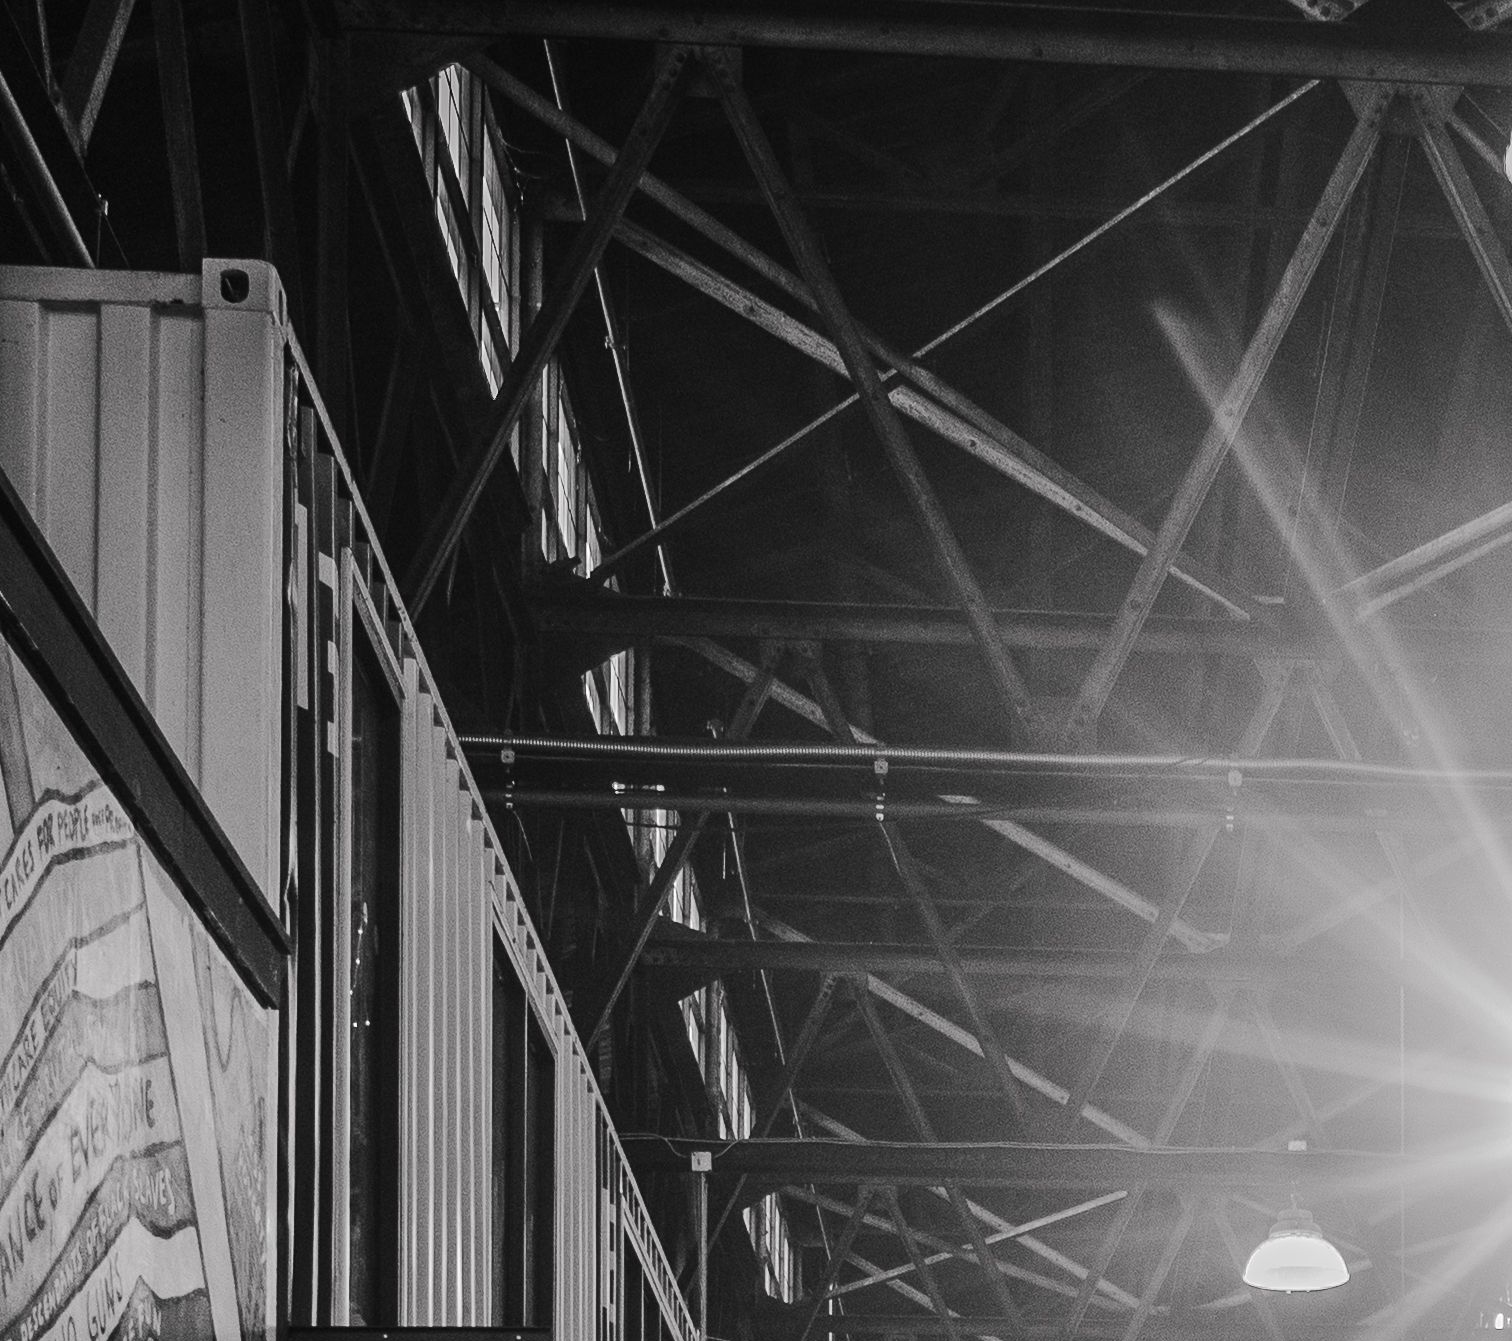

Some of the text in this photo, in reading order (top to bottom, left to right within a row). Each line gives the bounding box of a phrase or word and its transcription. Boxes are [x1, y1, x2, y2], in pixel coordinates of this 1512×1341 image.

[3, 842, 36, 913] CARES
[36, 814, 56, 858] FOR
[56, 804, 89, 842] PEOPLE
[47, 1164, 67, 1211] OF
[131, 1166, 177, 1216] SLAVES
[86, 1251, 125, 1341] GUNS
